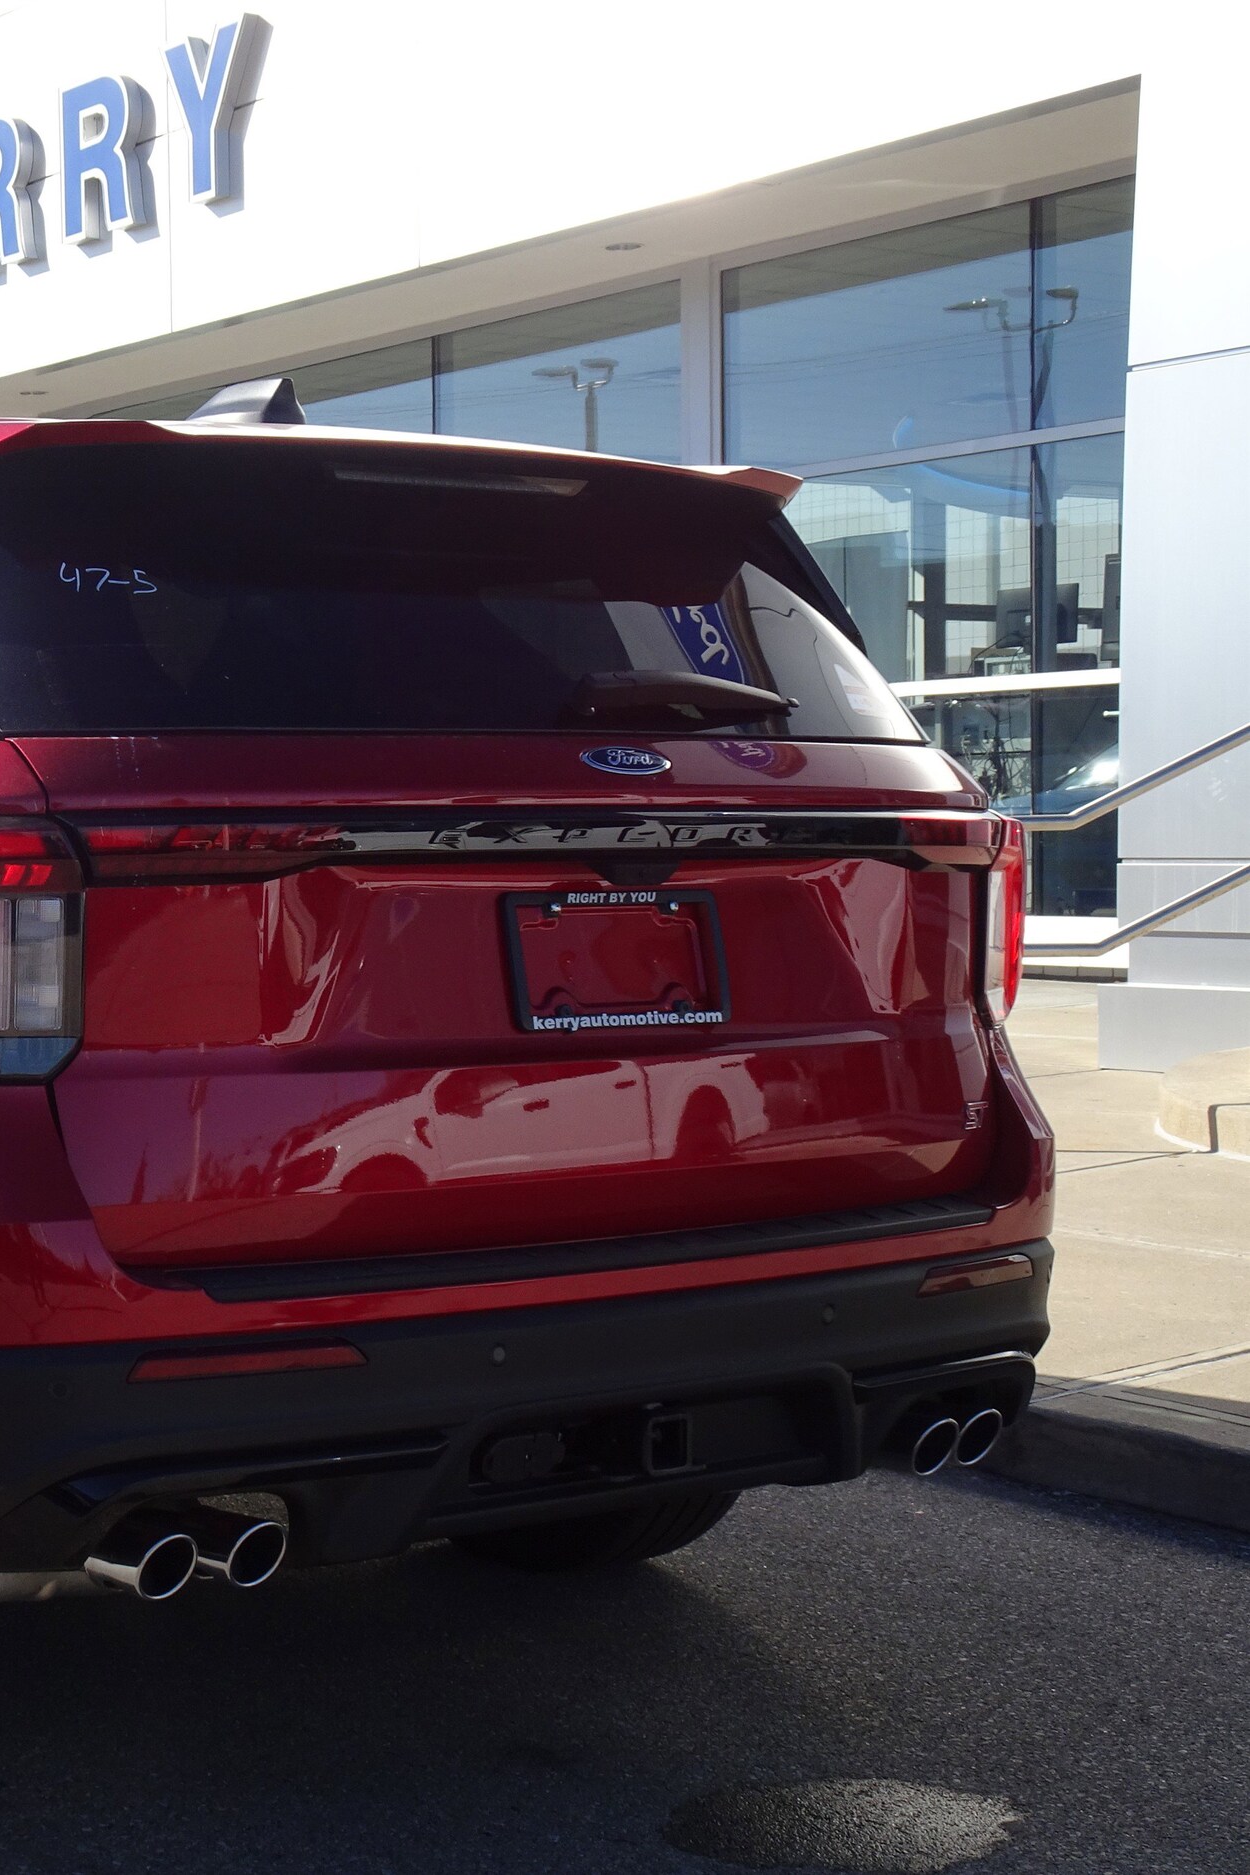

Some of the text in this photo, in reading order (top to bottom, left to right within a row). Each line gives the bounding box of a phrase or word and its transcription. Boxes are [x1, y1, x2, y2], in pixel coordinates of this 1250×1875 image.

[59, 562, 158, 594] 47-5
[607, 748, 654, 766] Ford
[429, 825, 860, 847] EXPLOR
[567, 891, 657, 904] RIGHT BY YOU
[532, 1010, 723, 1032] kerryautomotive.com
